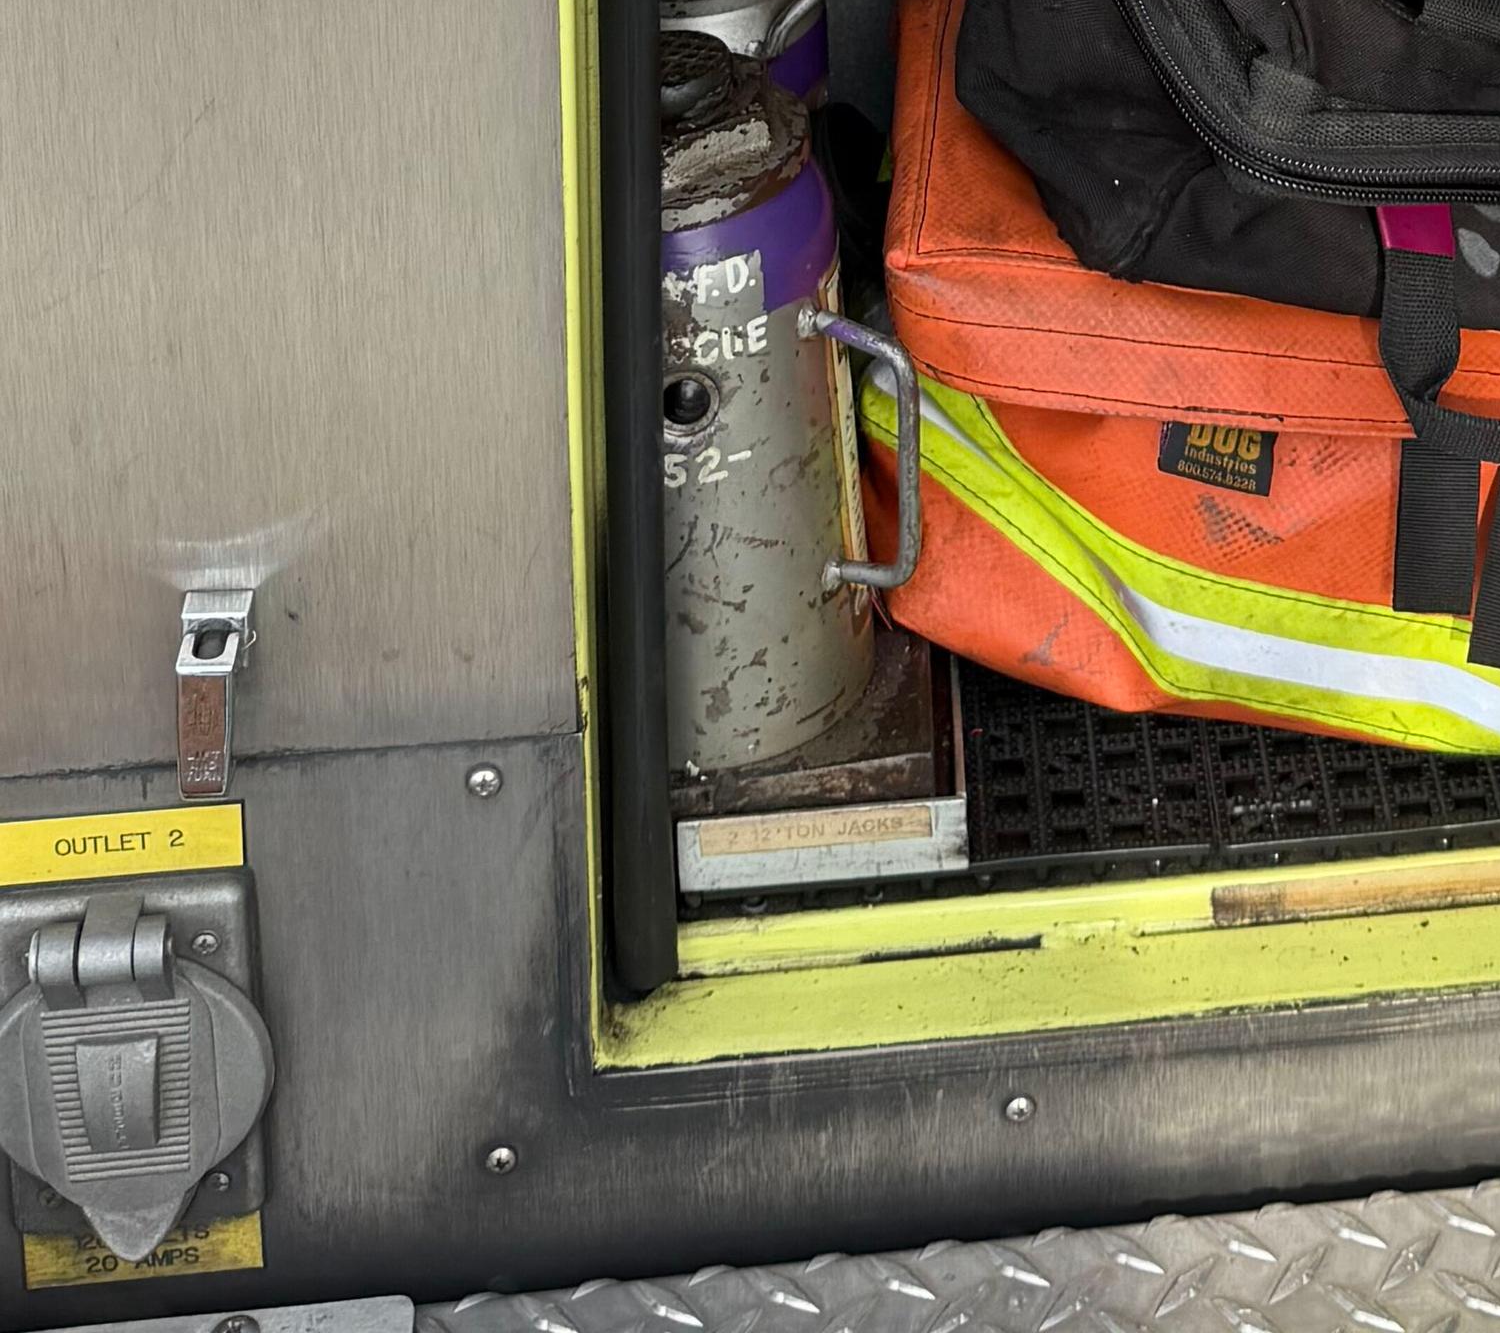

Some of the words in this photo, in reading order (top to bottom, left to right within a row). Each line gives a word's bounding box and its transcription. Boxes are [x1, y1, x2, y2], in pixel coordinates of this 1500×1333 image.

[837, 816, 904, 837] JACKS
[54, 831, 152, 857] OUTLET
[168, 828, 185, 848] 2
[85, 1254, 119, 1274] 20
[134, 1246, 201, 1270] AMPS
